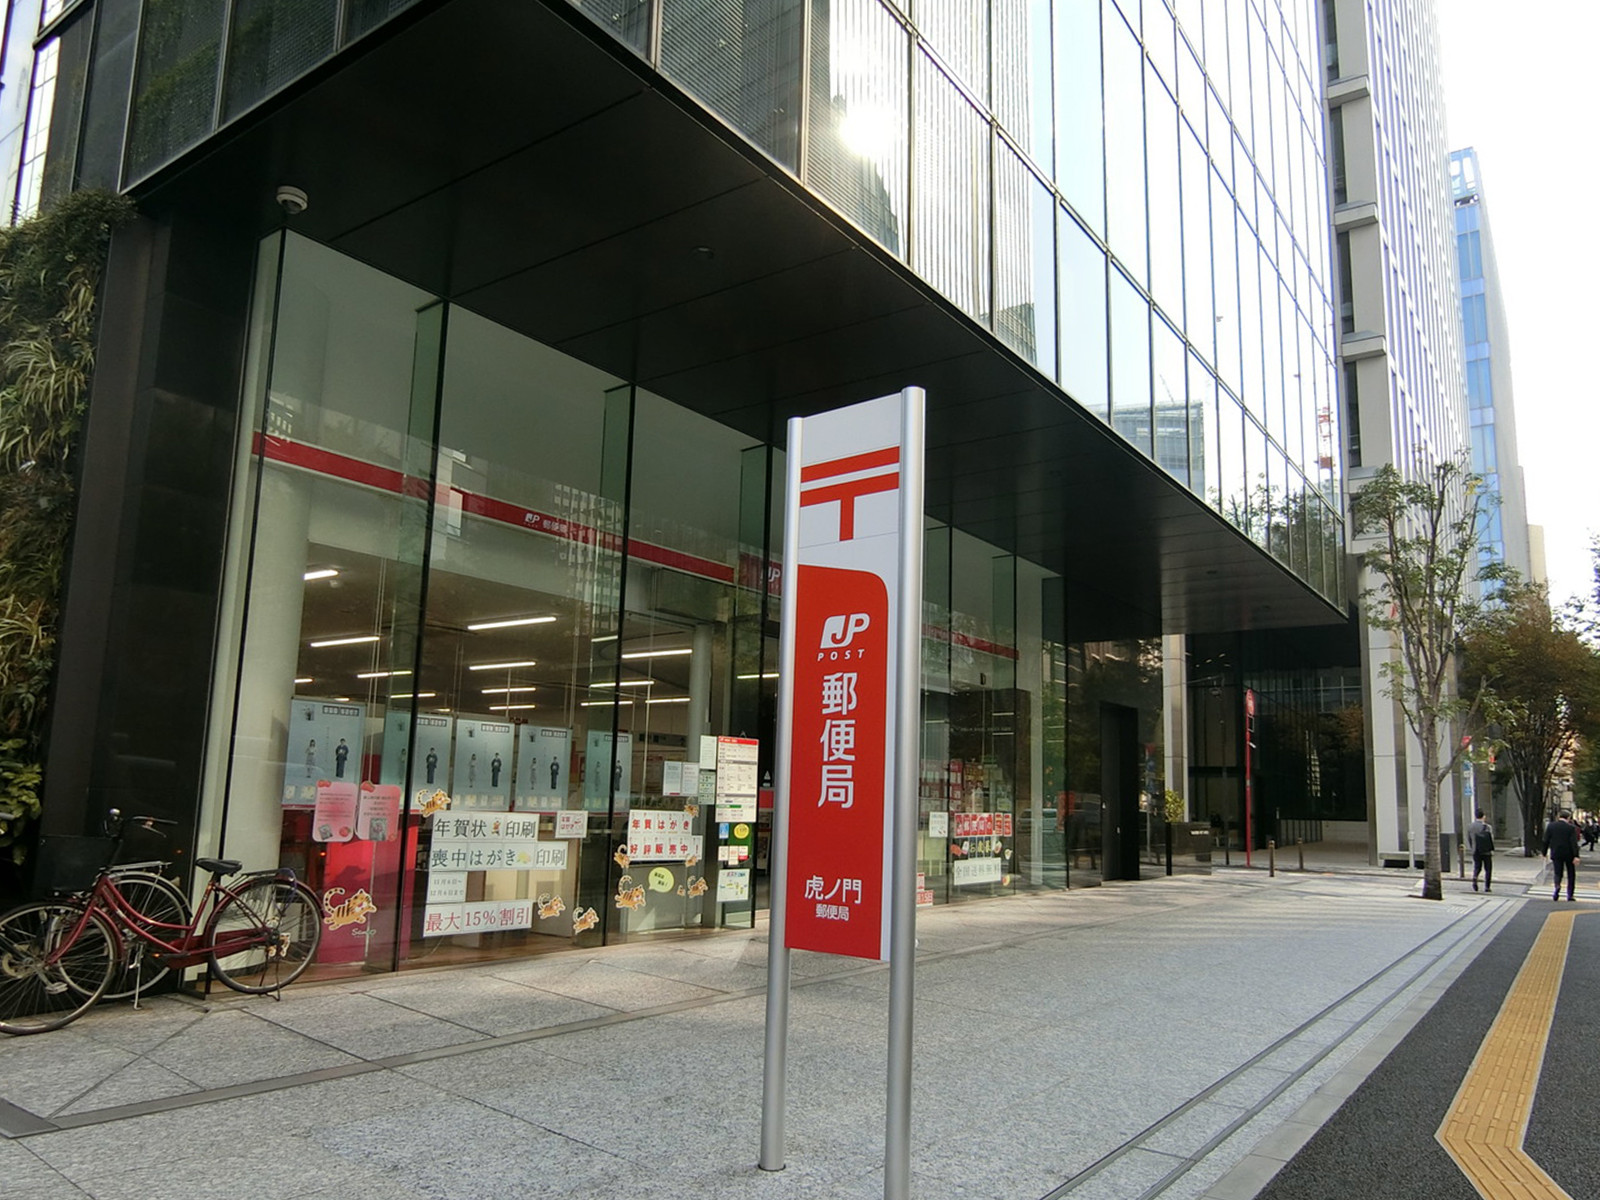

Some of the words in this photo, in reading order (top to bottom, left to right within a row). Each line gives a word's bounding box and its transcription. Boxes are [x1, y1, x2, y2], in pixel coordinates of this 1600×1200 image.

[820, 612, 870, 649] JP
[817, 648, 865, 662] POST
[818, 671, 858, 809] 郵便局
[434, 818, 487, 838] 年賀状
[505, 821, 536, 839] 印刷
[631, 818, 690, 831] 年賀はがき
[431, 848, 517, 868] 喪中はがき
[536, 848, 566, 866] 印刷
[804, 875, 862, 904] 虎ノ門
[425, 907, 530, 932] 最大15%割引
[815, 903, 850, 921] 郵便局
